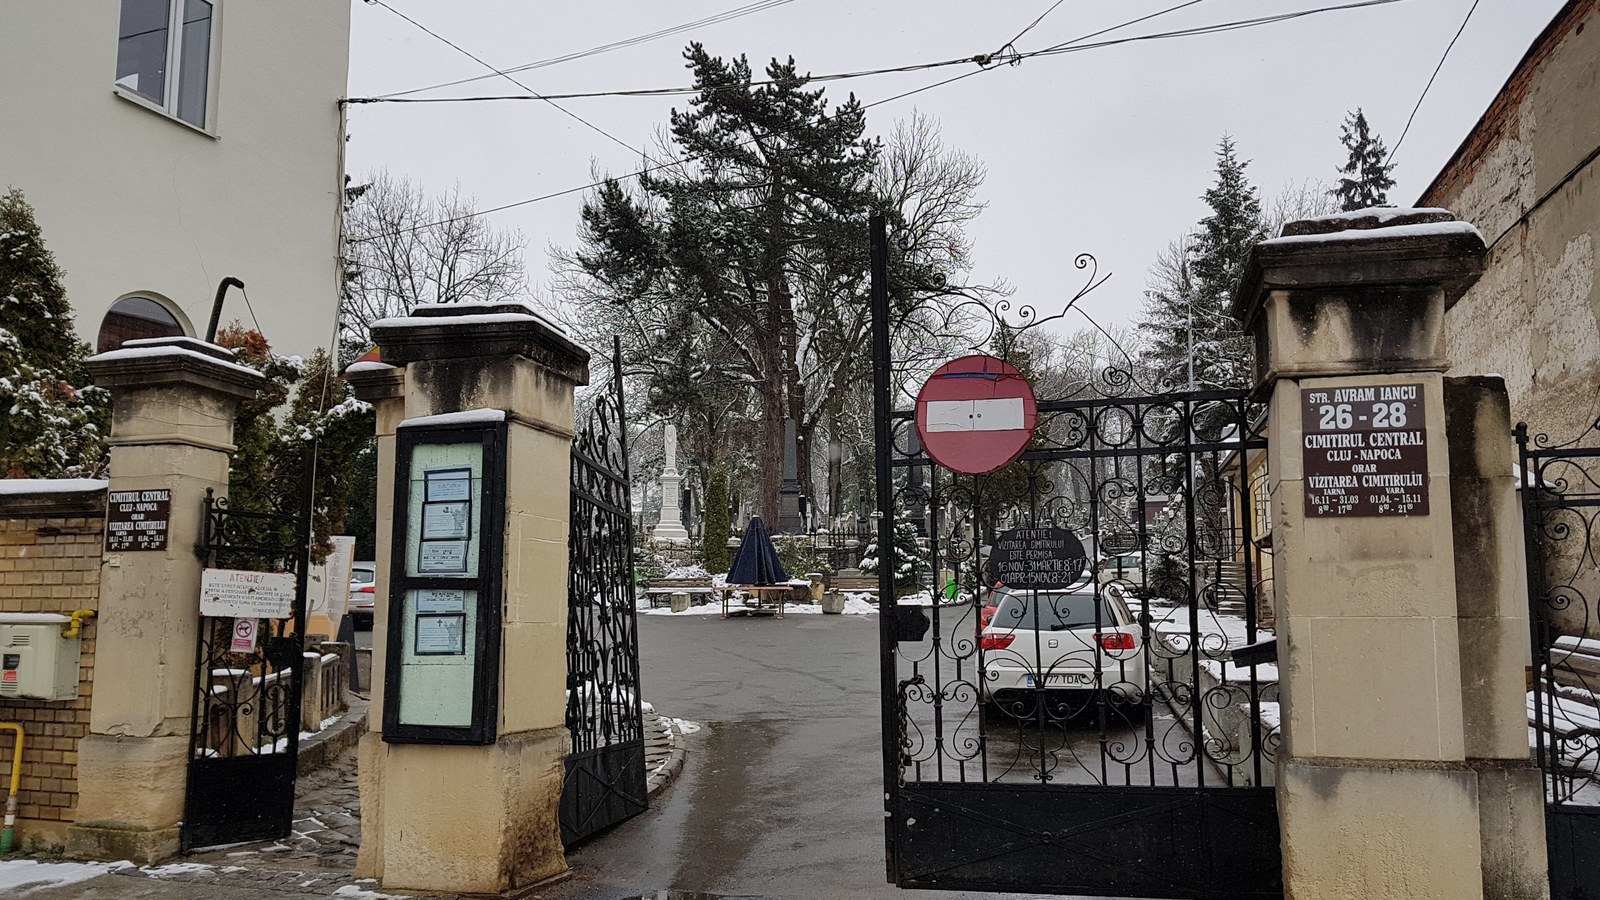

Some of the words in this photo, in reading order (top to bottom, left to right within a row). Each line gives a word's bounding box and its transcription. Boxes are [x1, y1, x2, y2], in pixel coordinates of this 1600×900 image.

[1309, 392, 1330, 404] STR.
[1334, 388, 1375, 402] AVRAM
[1380, 386, 1417, 400] IANCU
[1320, 404, 1353, 429] 26
[1372, 402, 1407, 428] 28
[1305, 433, 1365, 448] CIMITIRUL
[1370, 431, 1424, 447] CENTRAL
[1327, 450, 1352, 461] CLUJ
[1360, 448, 1402, 460] NAPOCA
[1352, 464, 1377, 473] ORAR
[1308, 475, 1359, 488] VIZITAREA
[1362, 474, 1423, 487] CIMITIRULUI
[110, 492, 140, 503] CIMITIRUL
[141, 491, 169, 502] CENTRAL
[1324, 488, 1346, 496] IARNA
[1311, 496, 1330, 505] 16.11
[1339, 495, 1359, 504] 31.03
[1402, 494, 1421, 503] 15.11
[120, 503, 133, 512] CLUJ
[136, 502, 157, 512] NAPOCA
[1009, 551, 1023, 560] ESTE
